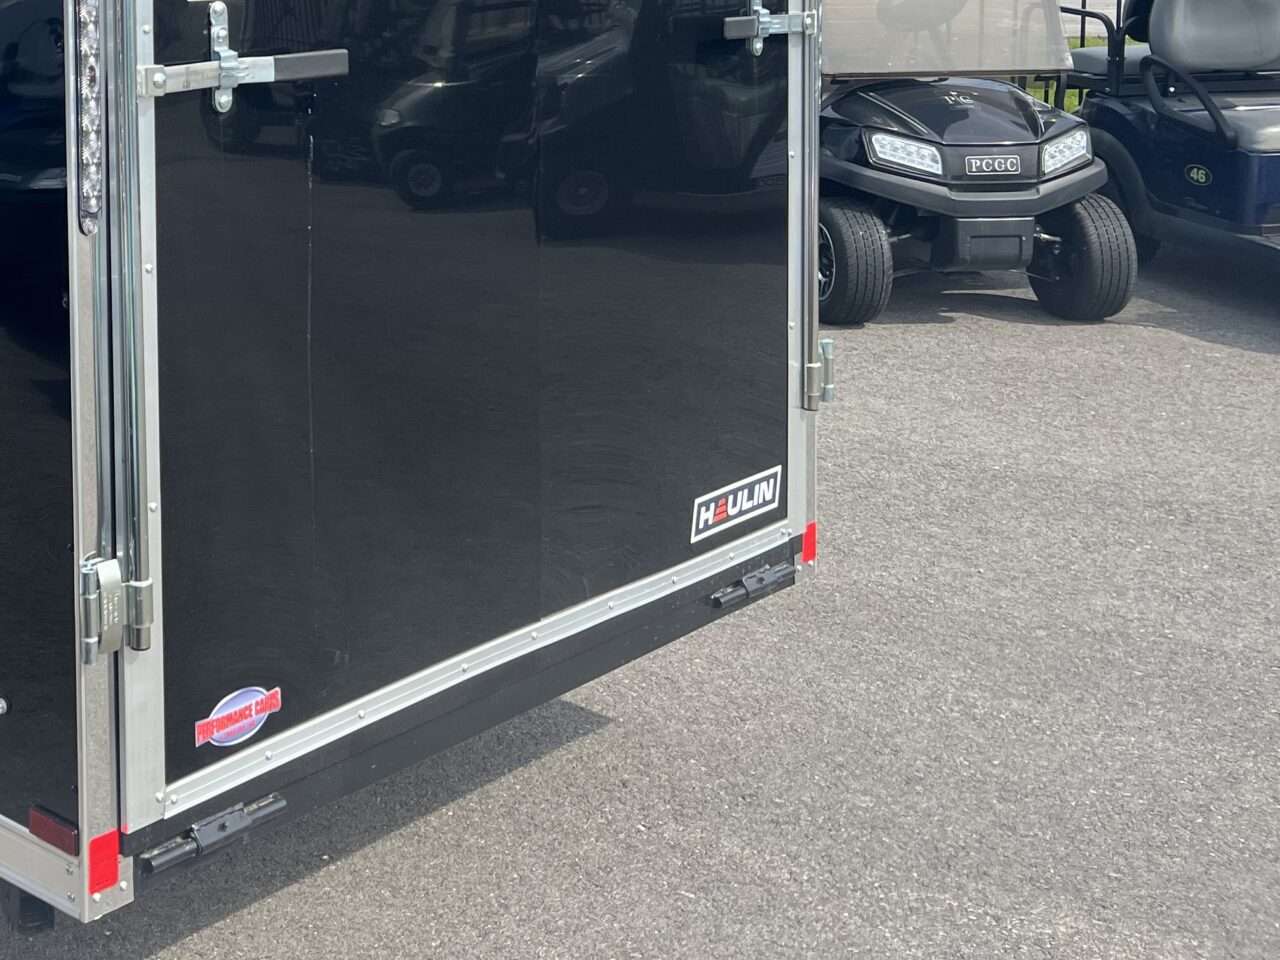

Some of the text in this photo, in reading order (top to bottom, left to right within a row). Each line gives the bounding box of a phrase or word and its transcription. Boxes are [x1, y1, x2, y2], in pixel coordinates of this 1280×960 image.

[970, 158, 1017, 172] PCGC
[1190, 167, 1206, 183] 46
[698, 478, 775, 530] HAULIN
